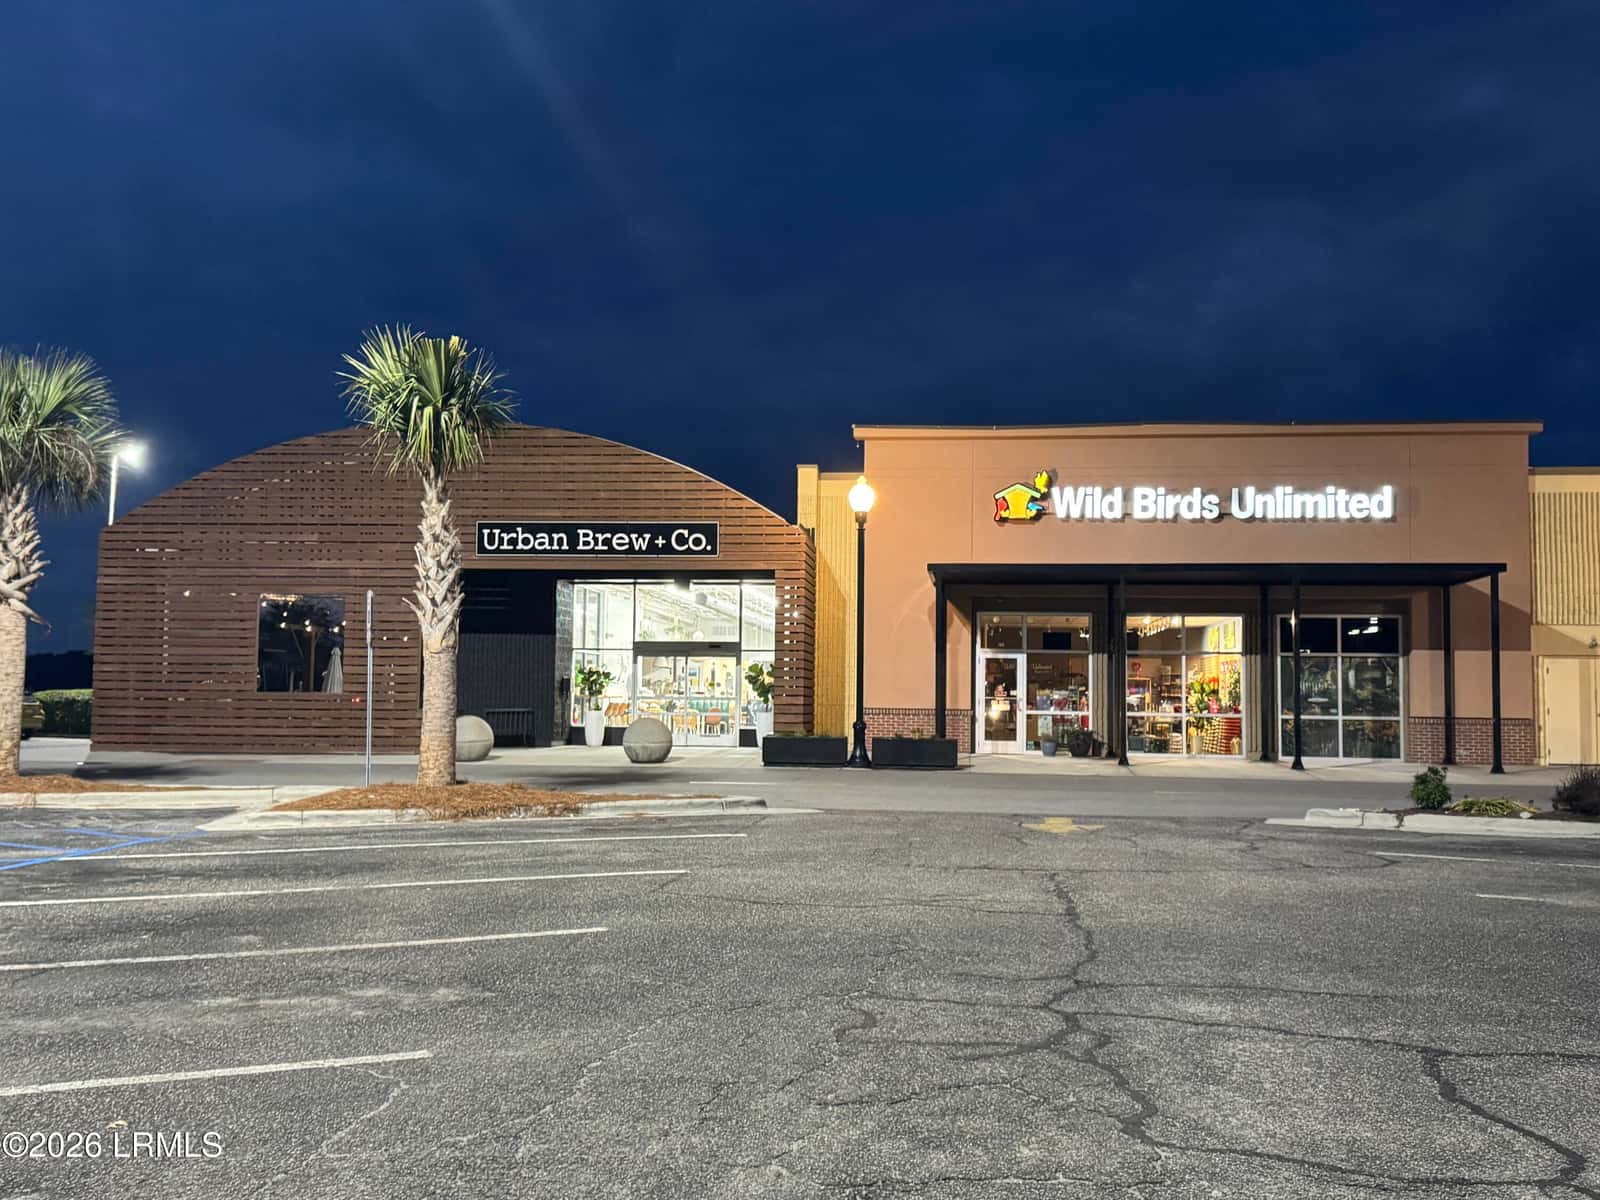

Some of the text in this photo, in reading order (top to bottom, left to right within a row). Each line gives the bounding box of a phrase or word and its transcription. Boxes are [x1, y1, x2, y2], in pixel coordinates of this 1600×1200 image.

[1052, 485, 1394, 520] Wild Birds Unlimited
[482, 527, 569, 550] Urban
[577, 529, 652, 551] Brew
[671, 529, 713, 551] Co.
